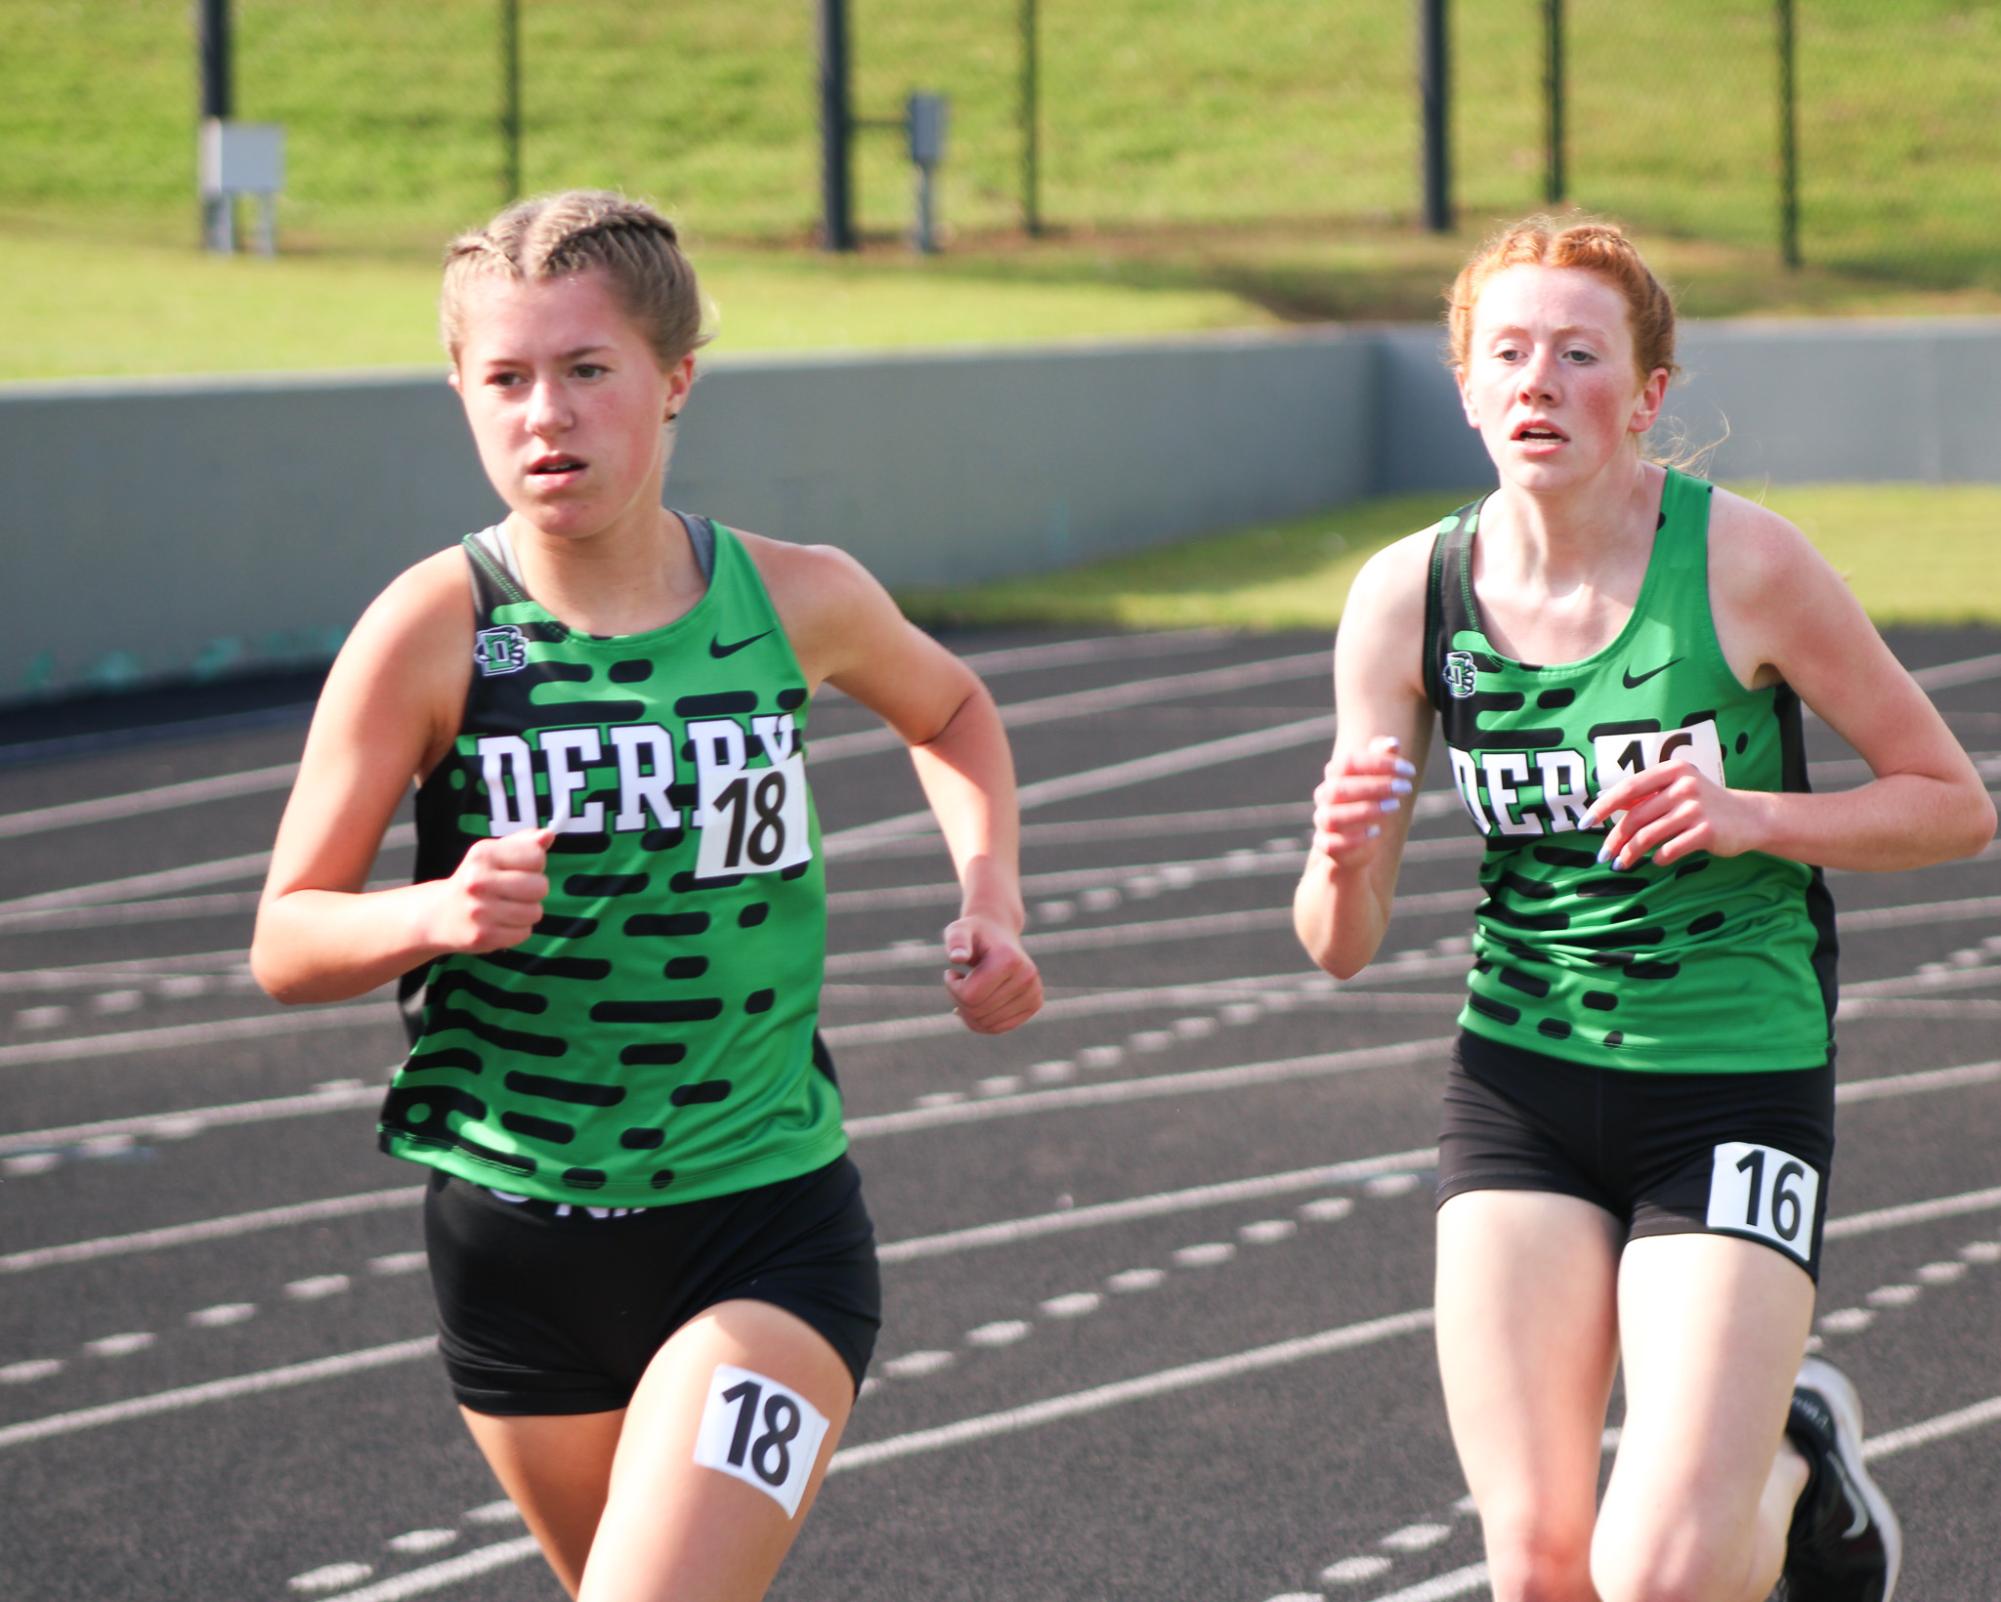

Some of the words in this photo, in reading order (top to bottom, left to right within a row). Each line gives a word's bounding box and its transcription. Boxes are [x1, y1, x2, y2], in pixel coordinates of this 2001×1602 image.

[712, 770, 787, 868] 18
[1735, 1148, 1805, 1242] 16
[721, 1379, 801, 1488] 18
